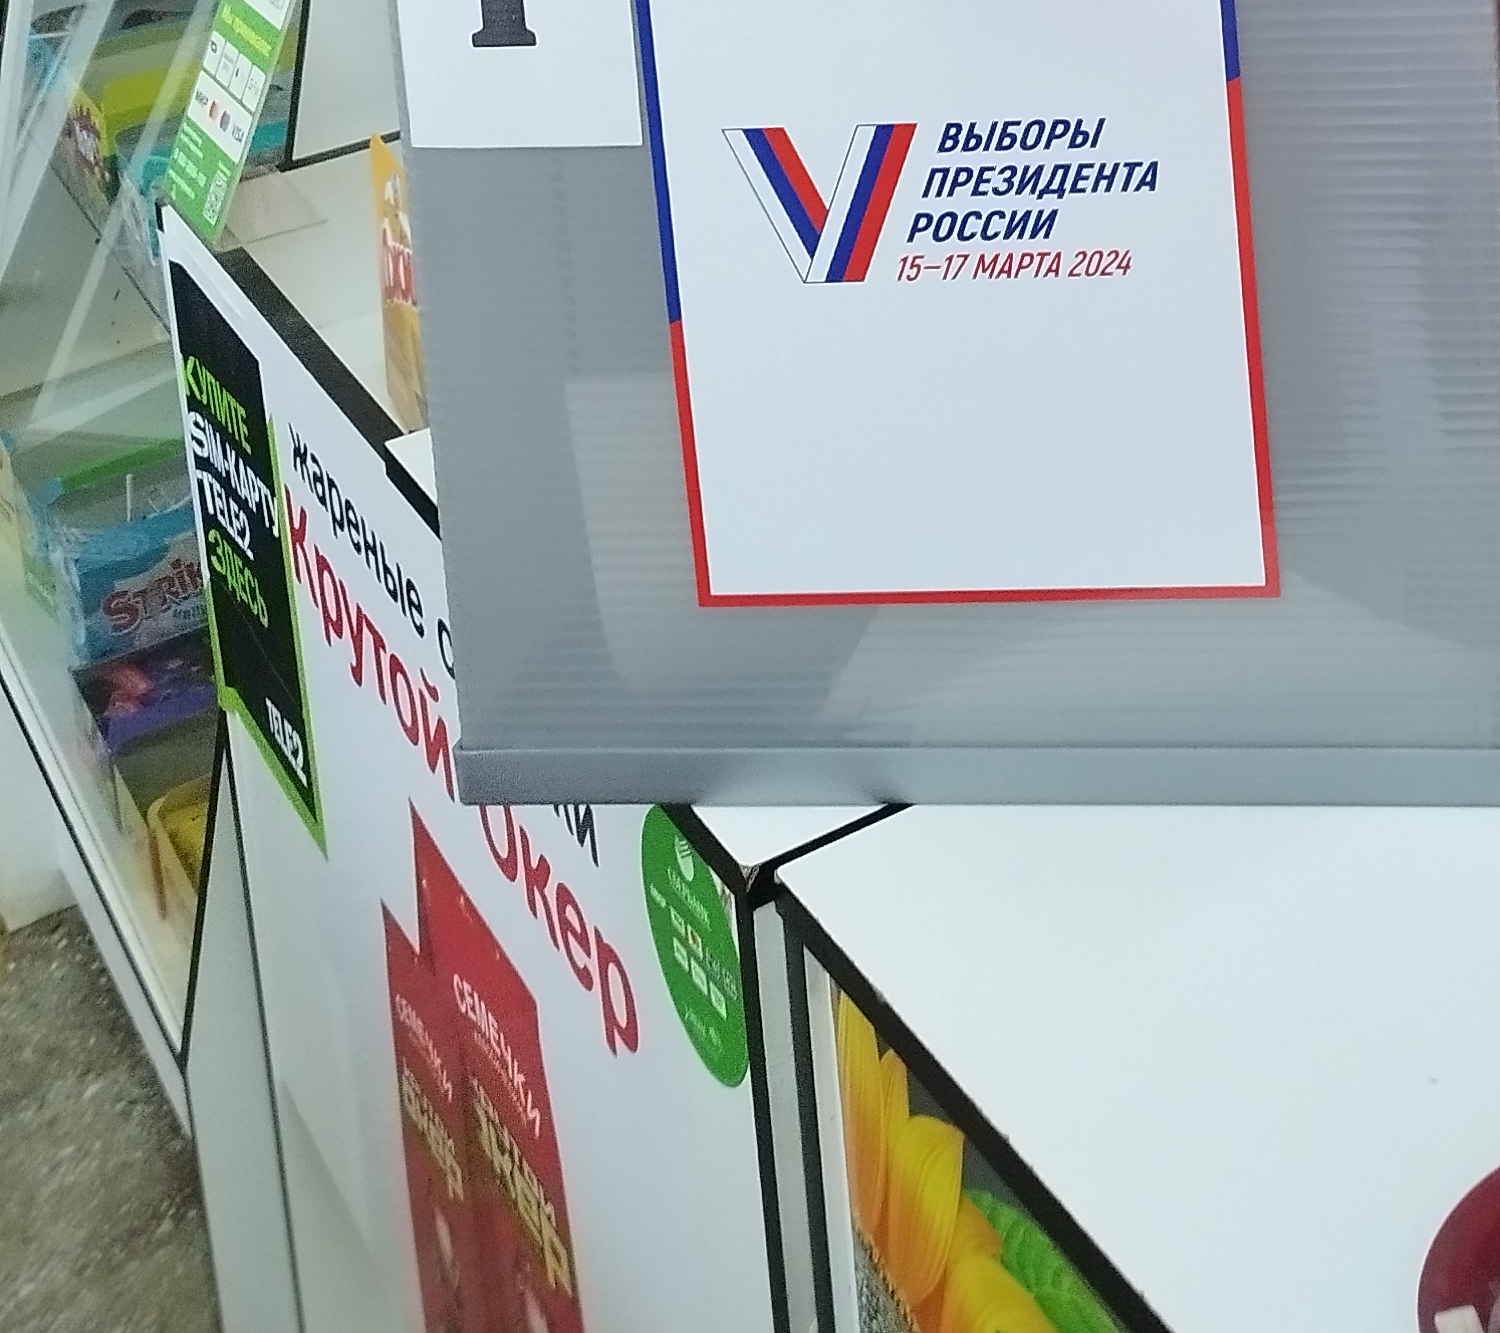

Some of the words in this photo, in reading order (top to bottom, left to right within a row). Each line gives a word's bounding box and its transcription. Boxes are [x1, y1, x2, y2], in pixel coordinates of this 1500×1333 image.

[920, 160, 1159, 200] ПРЕЗИДЕНТА
[936, 117, 1107, 154] ВЫБОРЫ
[905, 208, 1059, 244] РОССИИ
[971, 250, 1062, 280] МАРТА
[1067, 248, 1133, 278] 2024
[184, 355, 252, 456] КУПИТЕ
[188, 410, 280, 539] SIM-КАРТУ
[194, 468, 255, 562] TELE2
[207, 528, 269, 630] ЗДЕСЬ
[290, 423, 425, 639] жареные
[284, 481, 456, 804] Крутой
[265, 696, 308, 788] TELE2
[453, 973, 541, 1140] СЕМЕЧКИ
